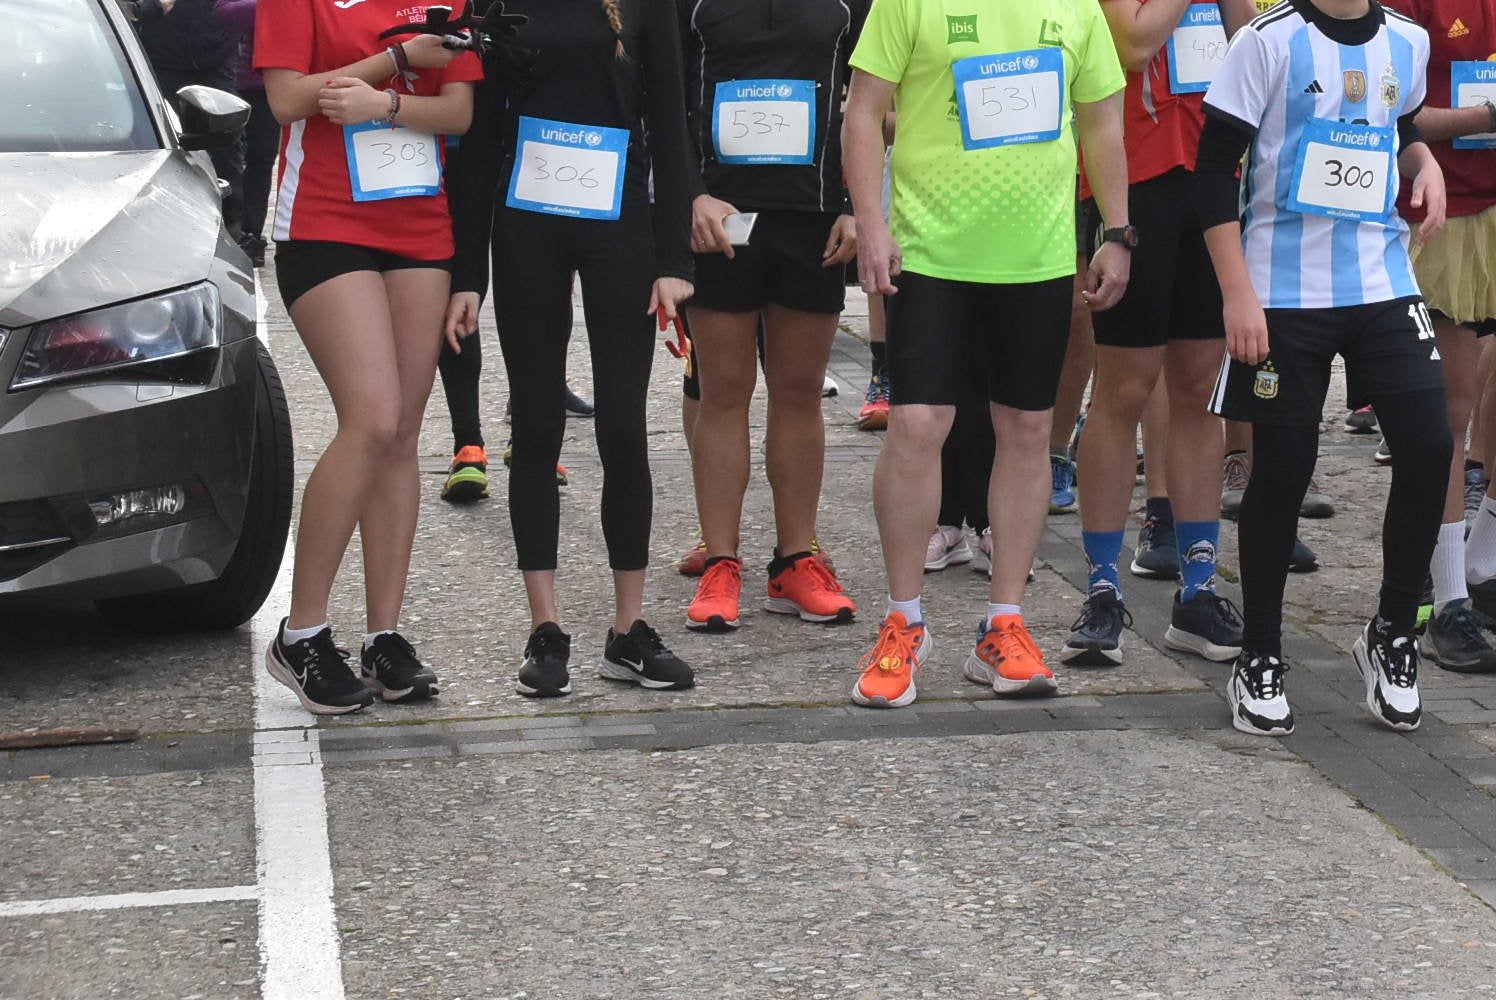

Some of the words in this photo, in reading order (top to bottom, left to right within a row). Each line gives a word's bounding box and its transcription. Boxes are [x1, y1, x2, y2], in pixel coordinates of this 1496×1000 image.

[951, 21, 975, 35] ibis
[980, 56, 1022, 75] unicef
[737, 84, 778, 99] unicef
[981, 86, 1037, 117] 531
[732, 109, 791, 139] 537
[541, 128, 586, 144] unicef
[1330, 130, 1371, 146] unicef
[369, 142, 429, 170] 303
[534, 156, 599, 188] 306
[1324, 160, 1374, 189] 300
